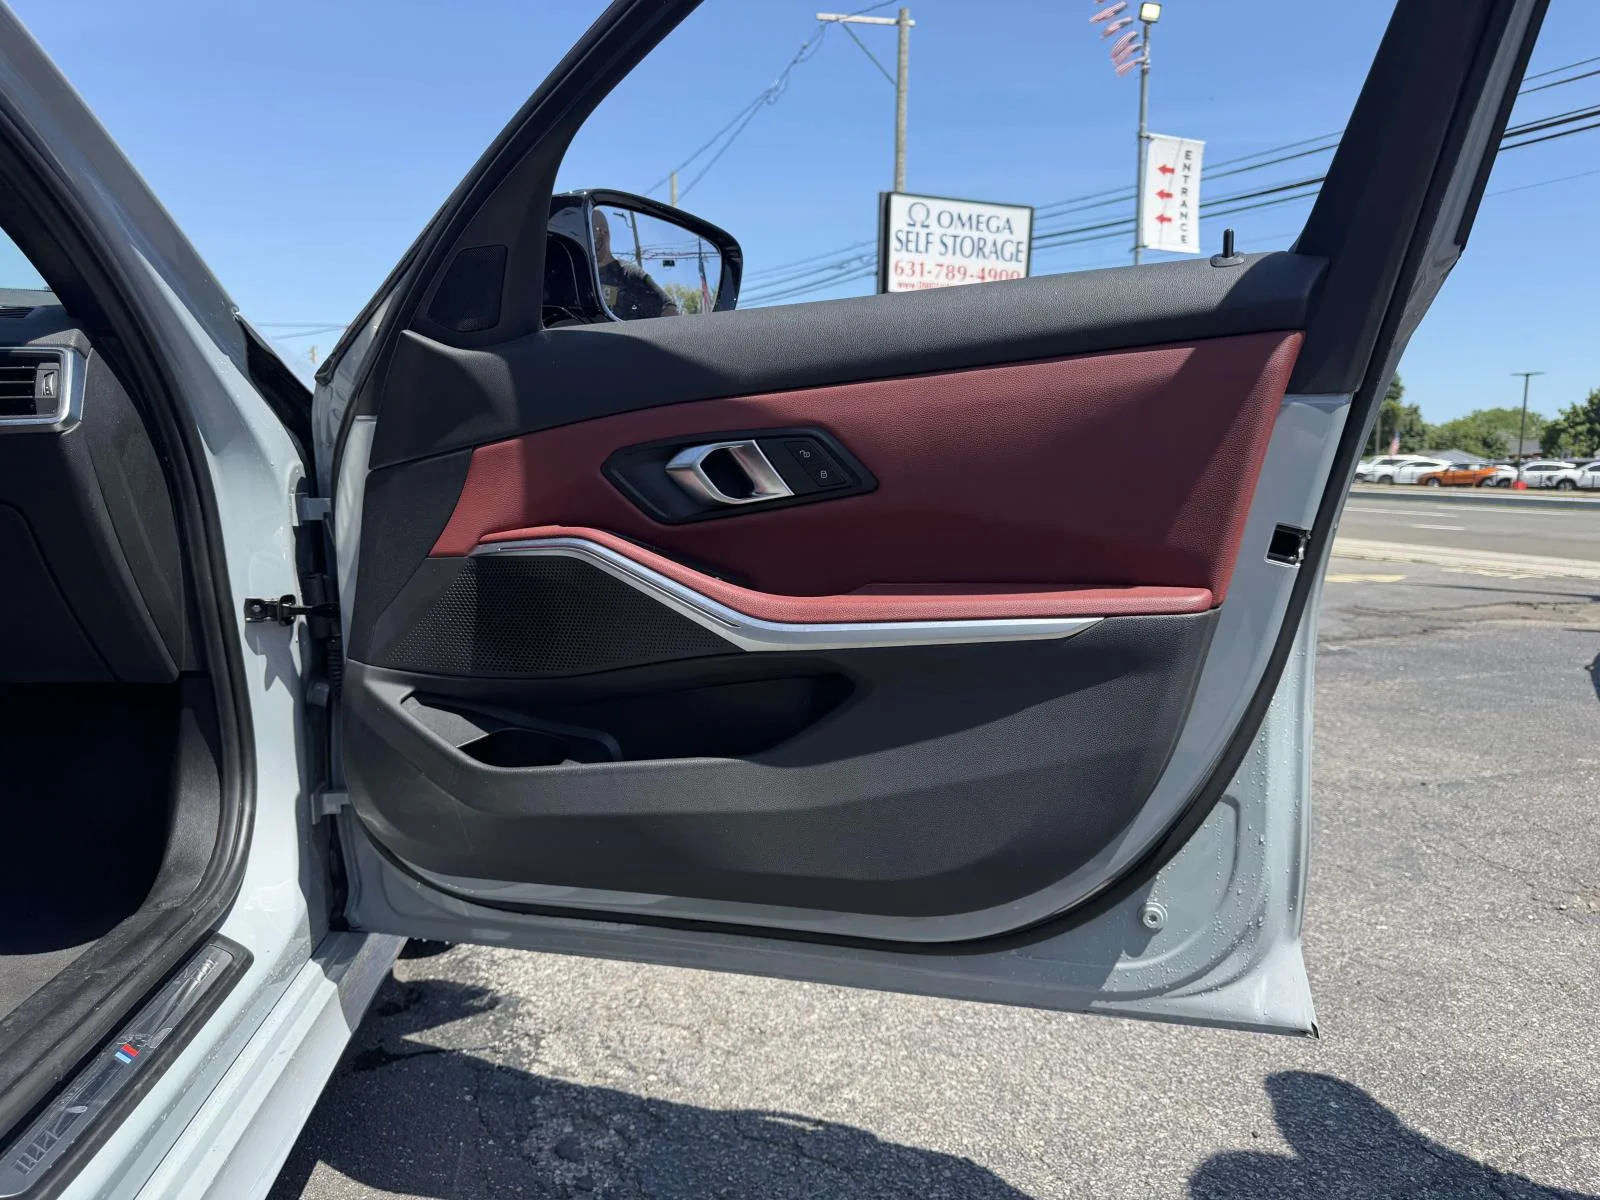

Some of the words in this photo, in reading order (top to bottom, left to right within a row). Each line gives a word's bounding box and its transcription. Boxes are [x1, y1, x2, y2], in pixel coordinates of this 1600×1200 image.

[1179, 150, 1192, 244] ENTRANCE
[937, 210, 1014, 235] OMEGA
[894, 229, 934, 253] SELF
[939, 234, 1024, 263] STORAGE
